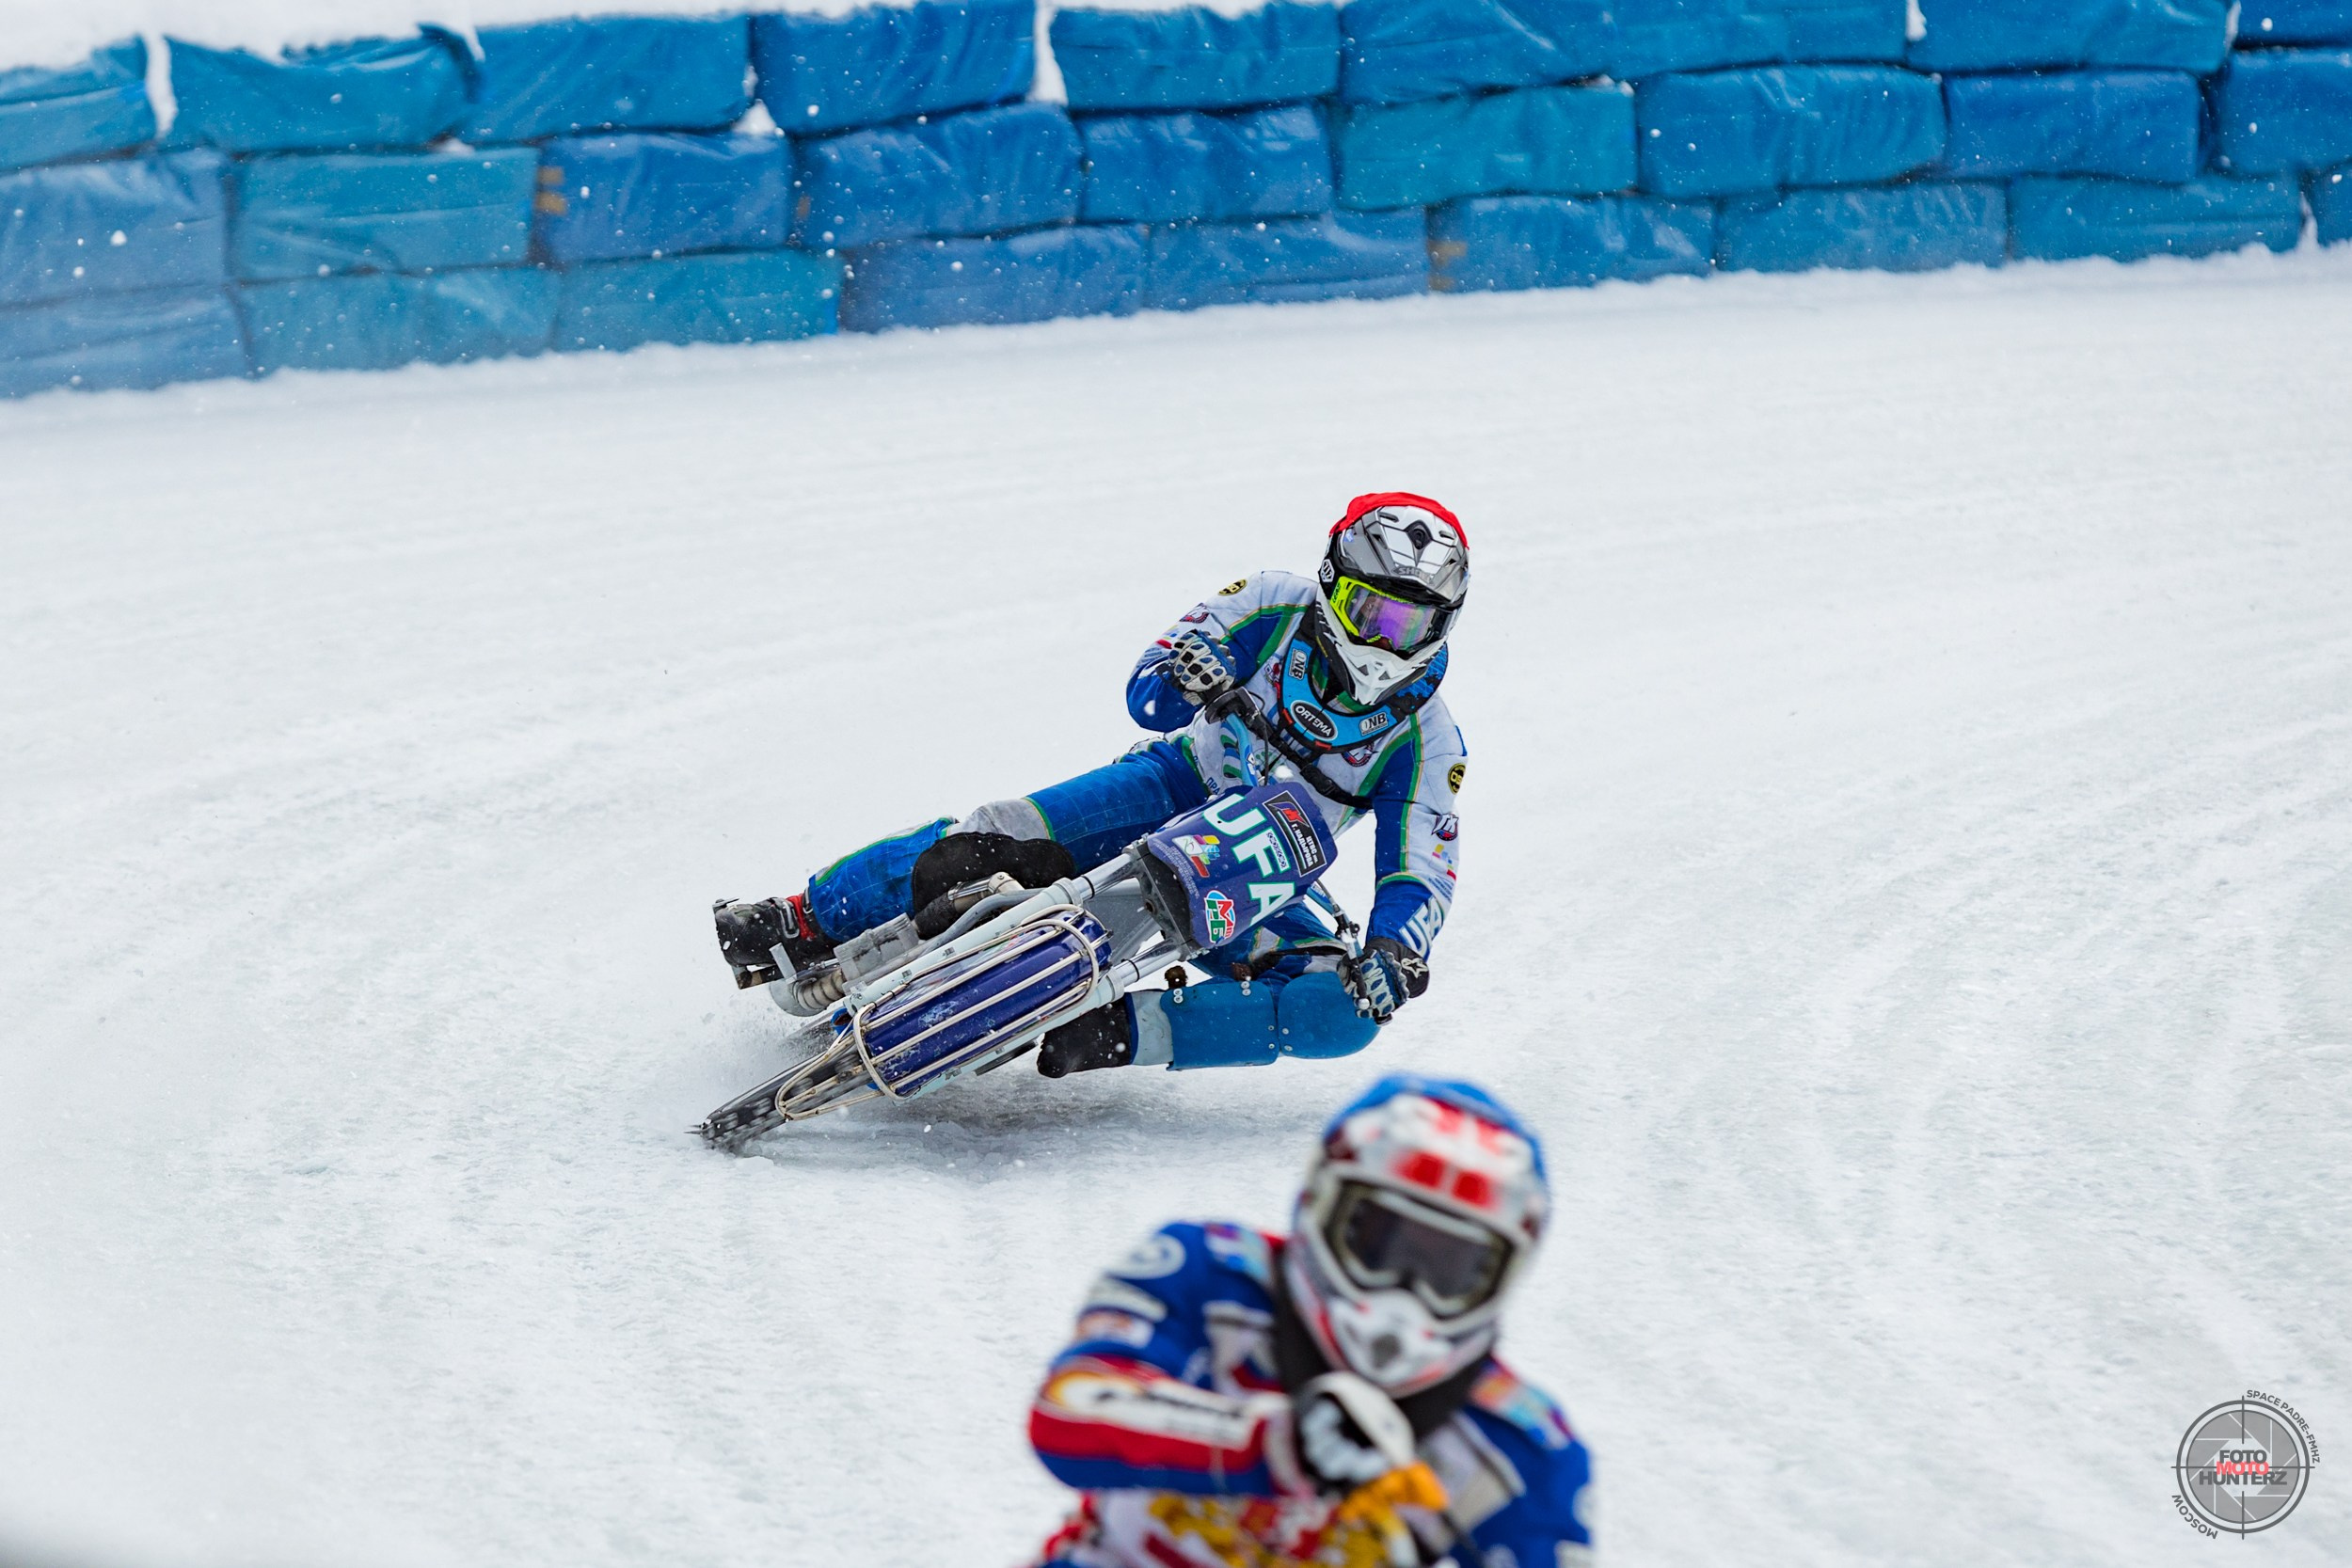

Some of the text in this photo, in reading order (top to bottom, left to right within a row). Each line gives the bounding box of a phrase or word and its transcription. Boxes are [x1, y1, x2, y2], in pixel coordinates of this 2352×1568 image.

[1295, 705, 1332, 736] ORTEMA
[1203, 793, 1295, 927] UFA
[1399, 895, 1443, 958] UFA
